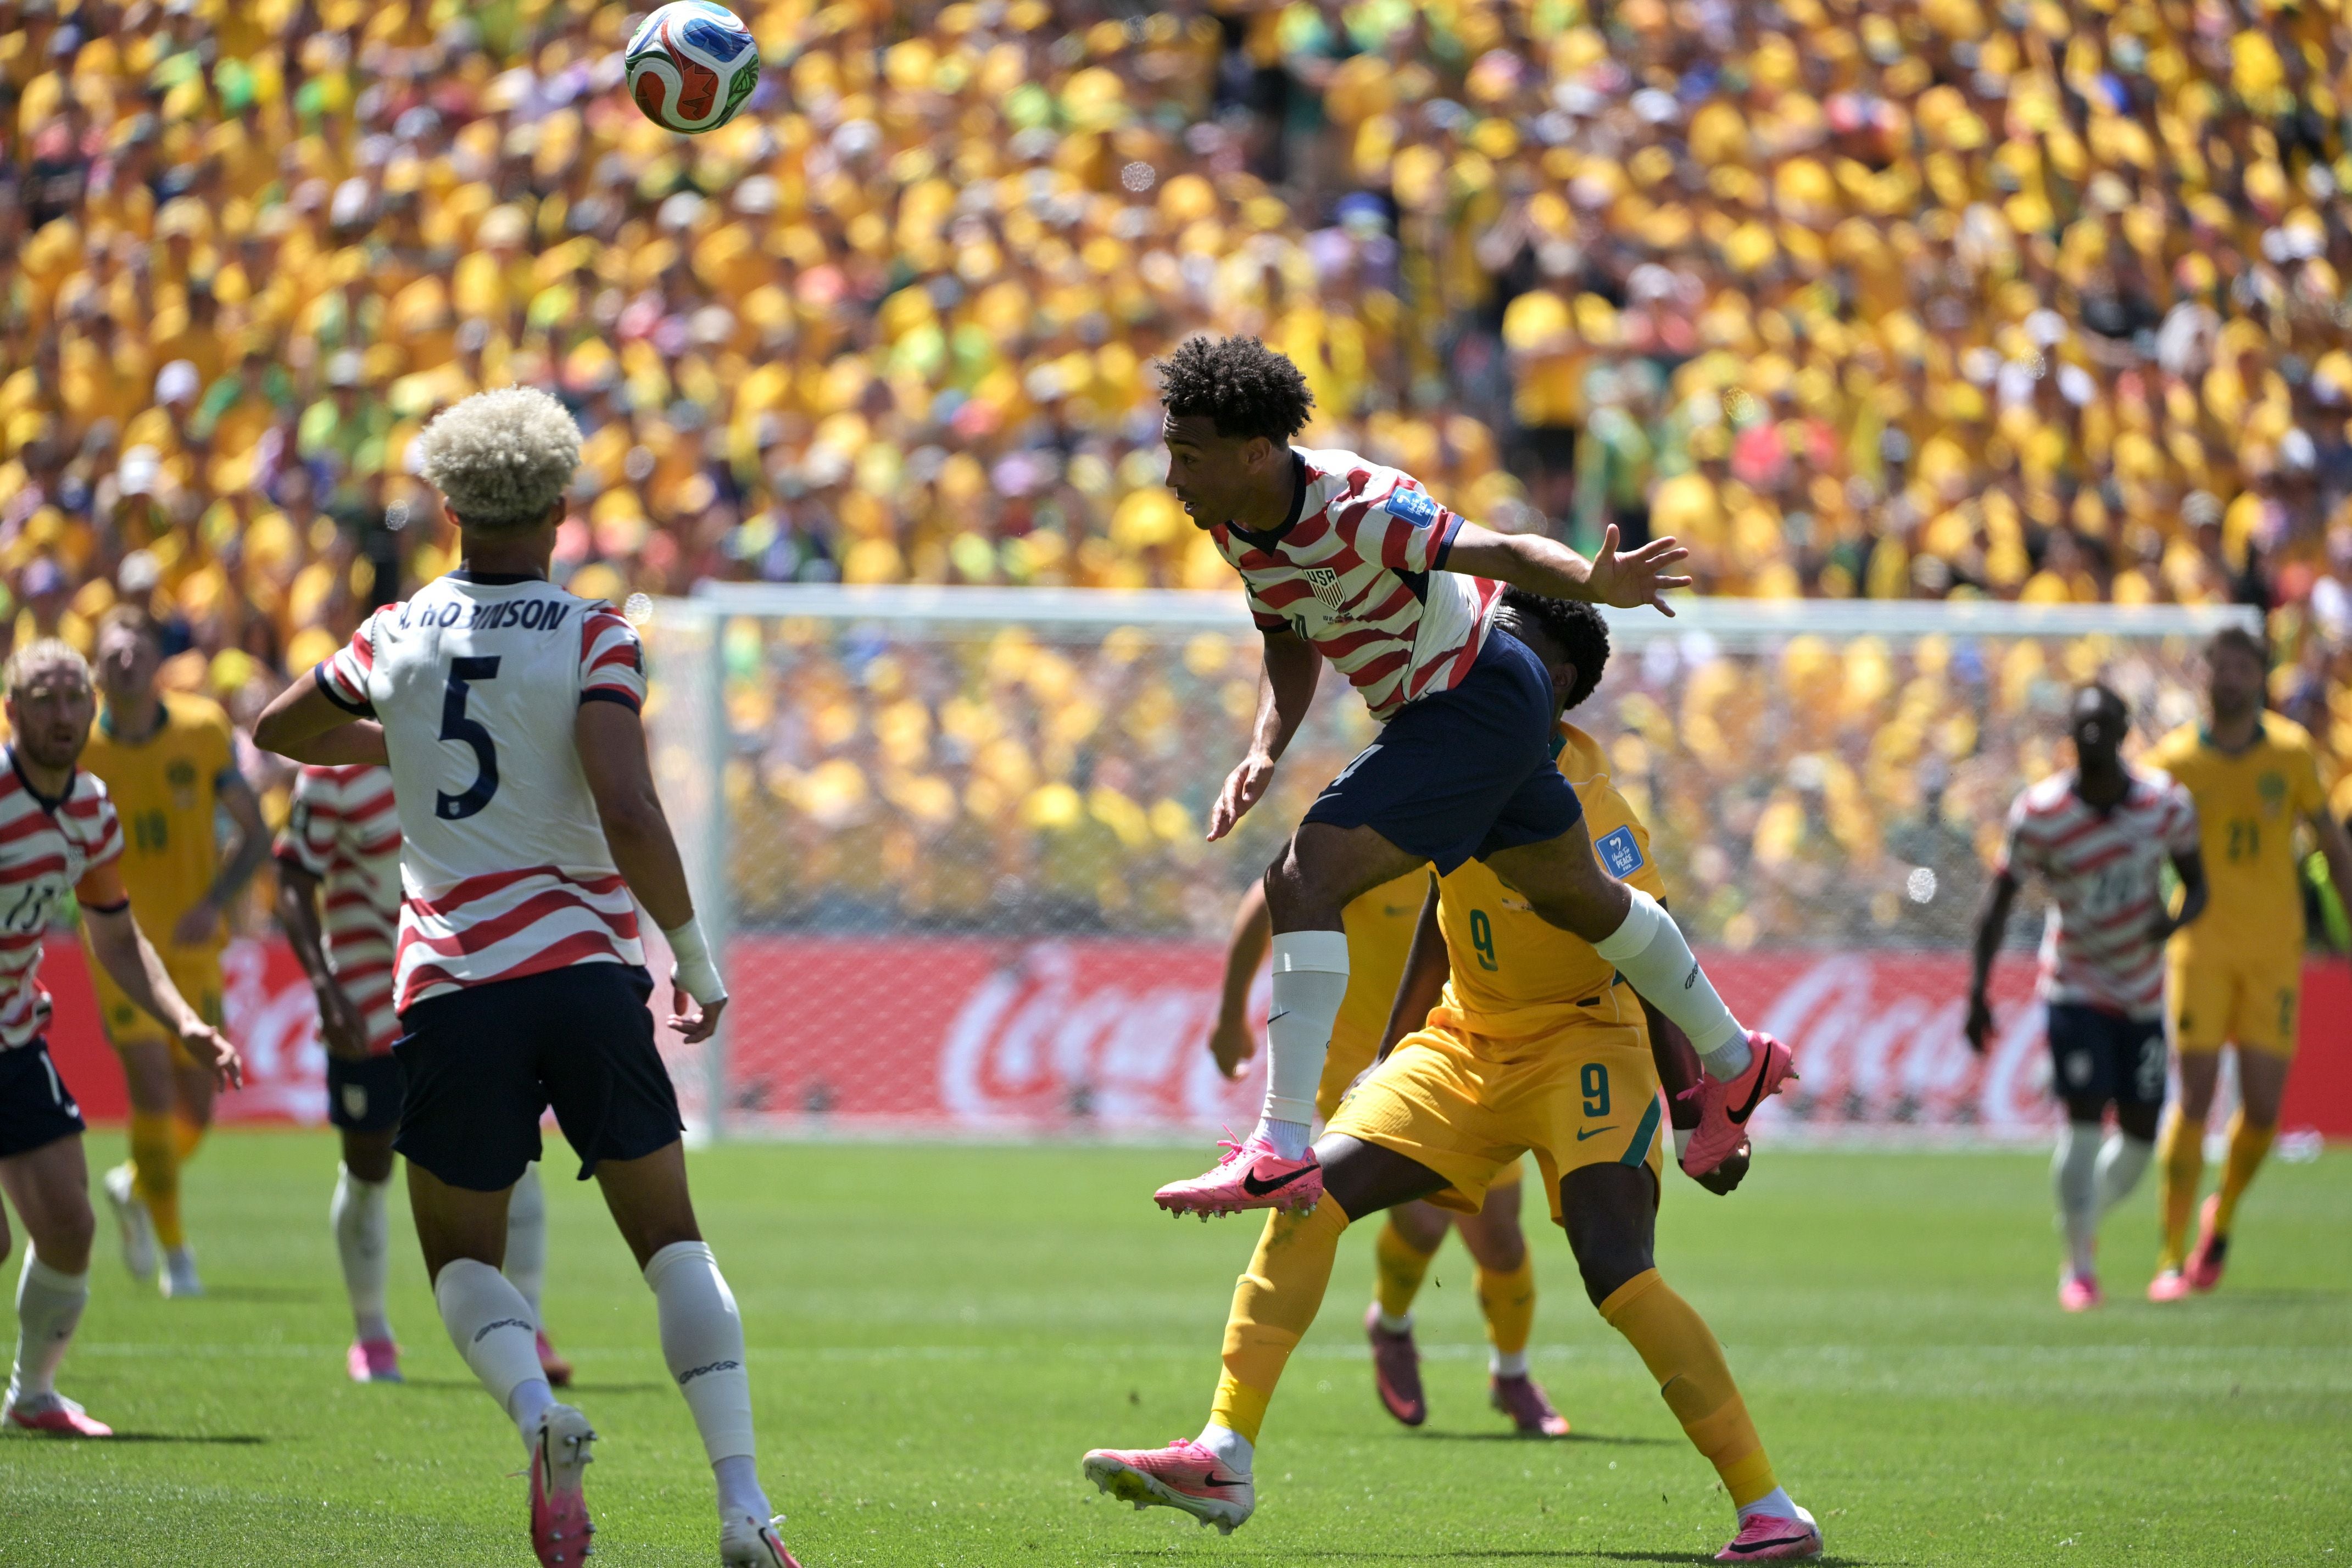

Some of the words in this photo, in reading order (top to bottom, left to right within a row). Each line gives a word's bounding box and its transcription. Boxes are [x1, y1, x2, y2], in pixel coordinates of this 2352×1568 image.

[1415, 500, 1428, 516] PEACE
[1307, 569, 1335, 586] USA
[420, 599, 570, 631] ROBINSON
[434, 655, 502, 820] 5
[1612, 850, 1624, 862] Unite
[1616, 853, 1634, 869] PEACE
[1470, 908, 1498, 972] 9
[1580, 1062, 1610, 1117] 9
